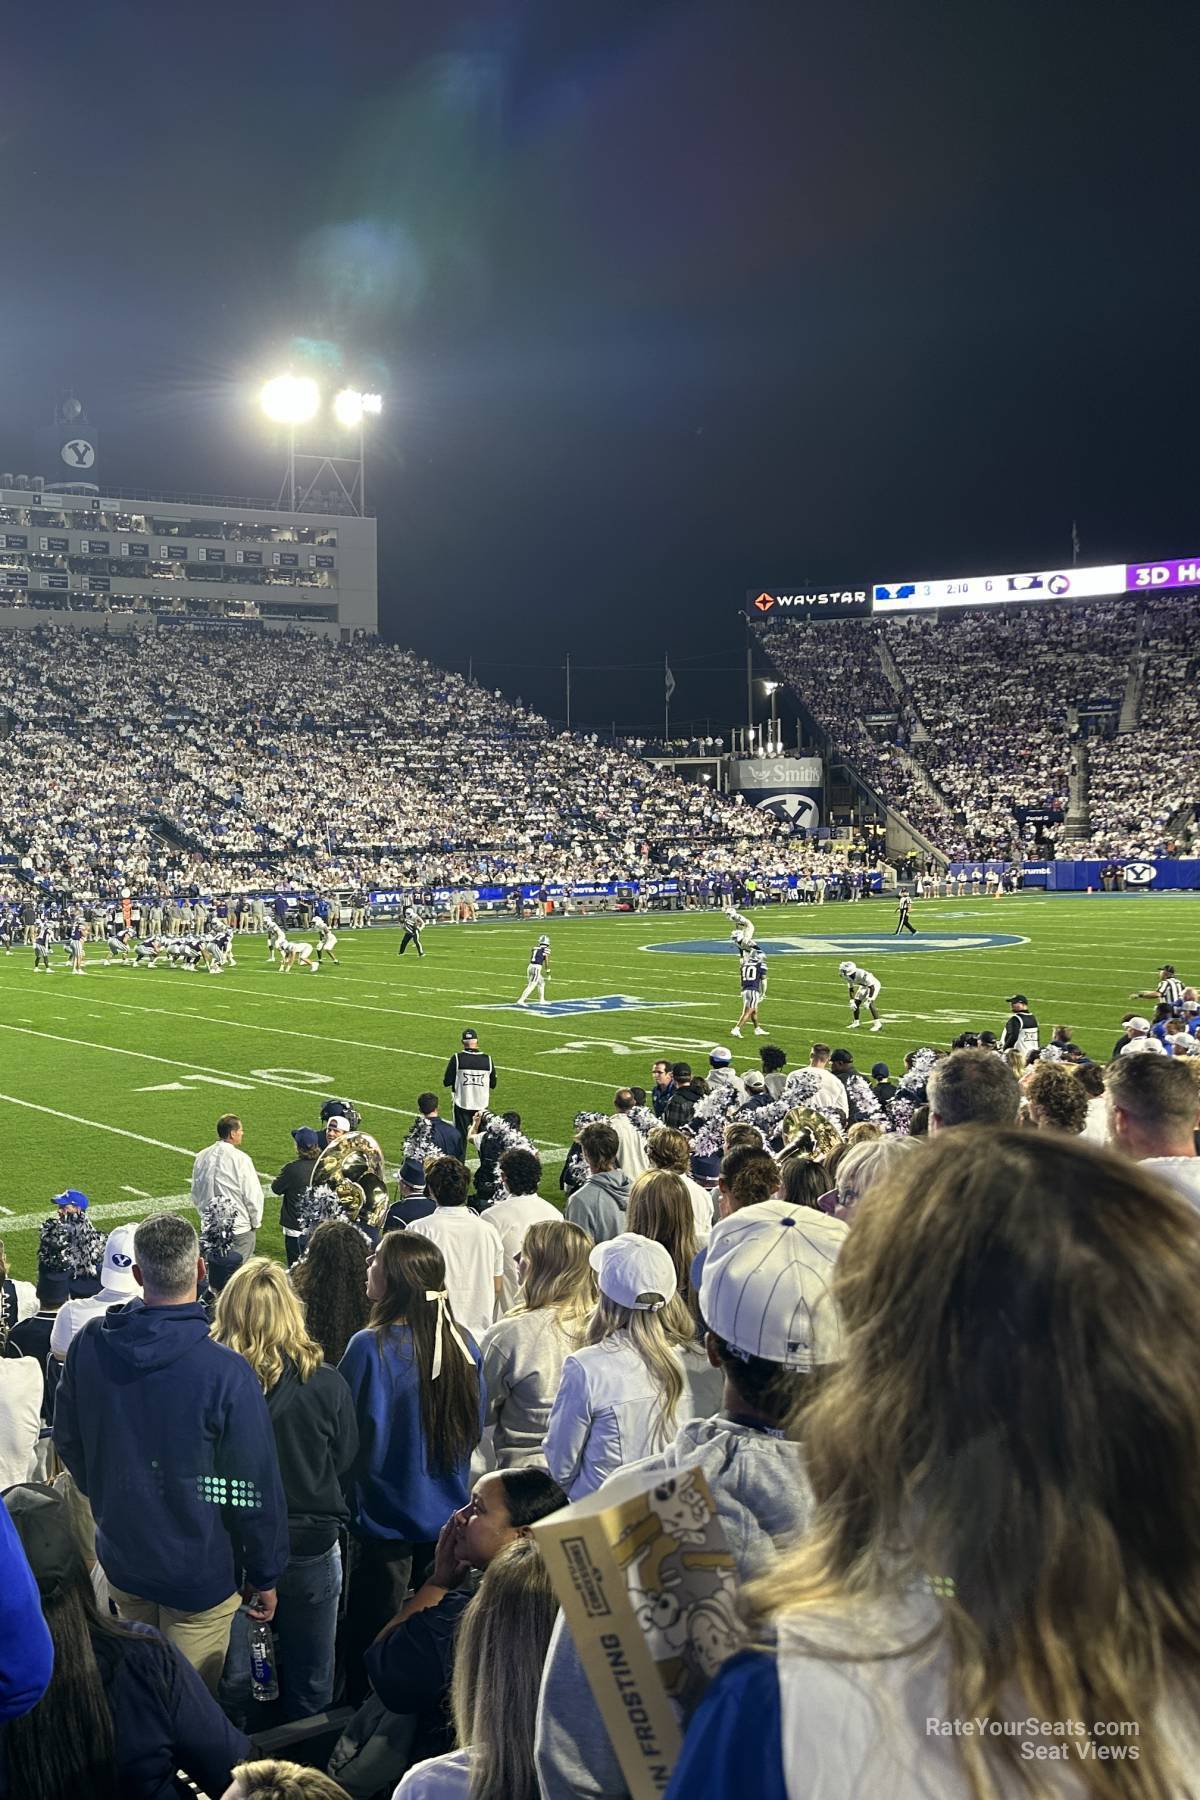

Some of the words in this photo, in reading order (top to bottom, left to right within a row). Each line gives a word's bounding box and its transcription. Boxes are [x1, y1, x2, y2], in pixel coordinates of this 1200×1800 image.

[1136, 567, 1170, 586] 3D
[1178, 564, 1200, 582] H
[777, 591, 866, 606] WAYSTAR
[741, 966, 757, 981] 10
[179, 1068, 336, 1090] 10
[601, 1633, 660, 1757] FROSTING
